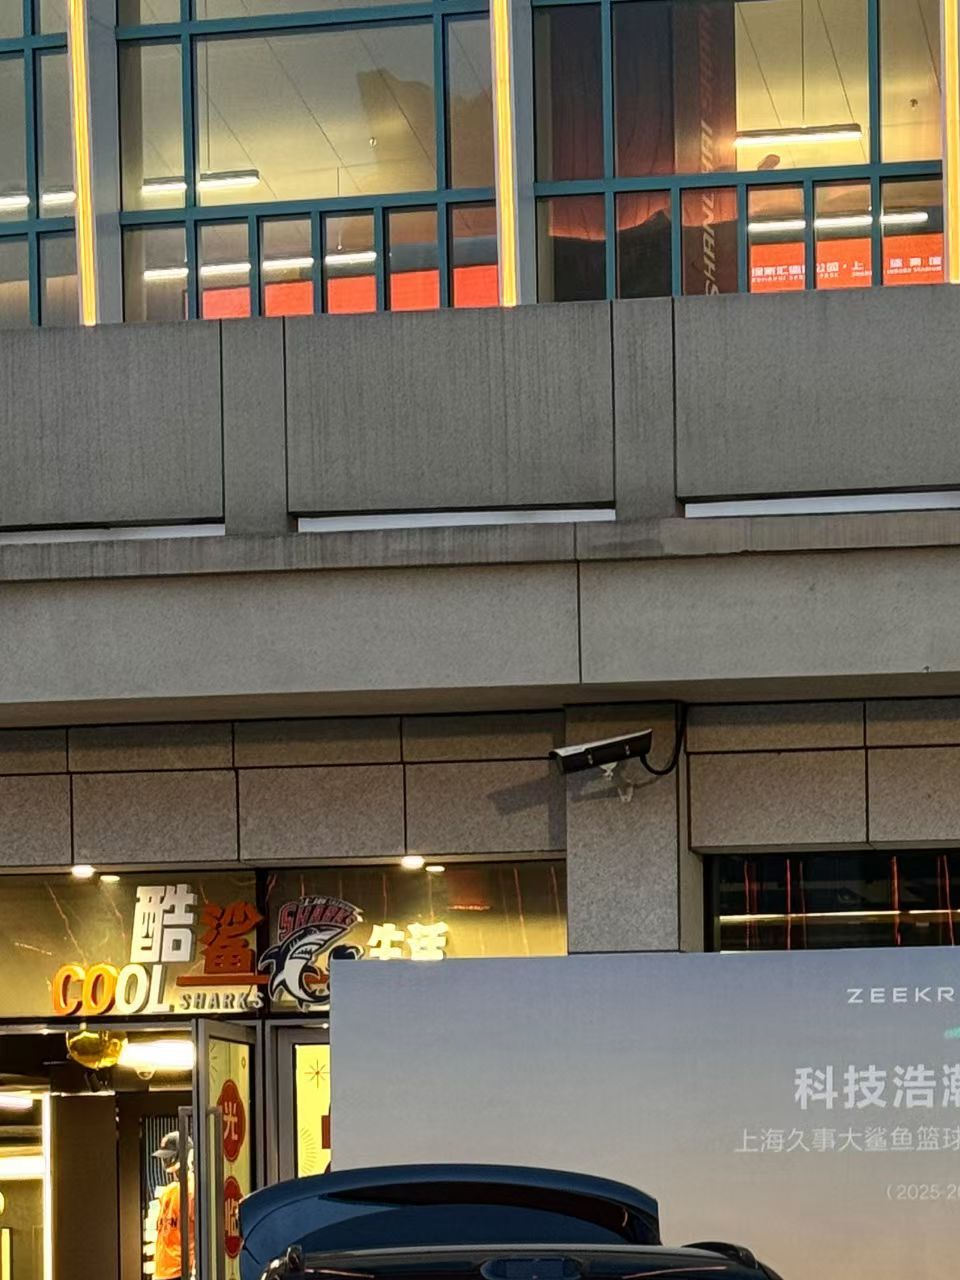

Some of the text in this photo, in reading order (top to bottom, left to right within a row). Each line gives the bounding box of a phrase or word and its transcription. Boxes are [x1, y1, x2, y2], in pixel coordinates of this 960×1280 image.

[52, 961, 264, 1015] COOL SHARKS
[847, 986, 956, 1003] ZEEKR
